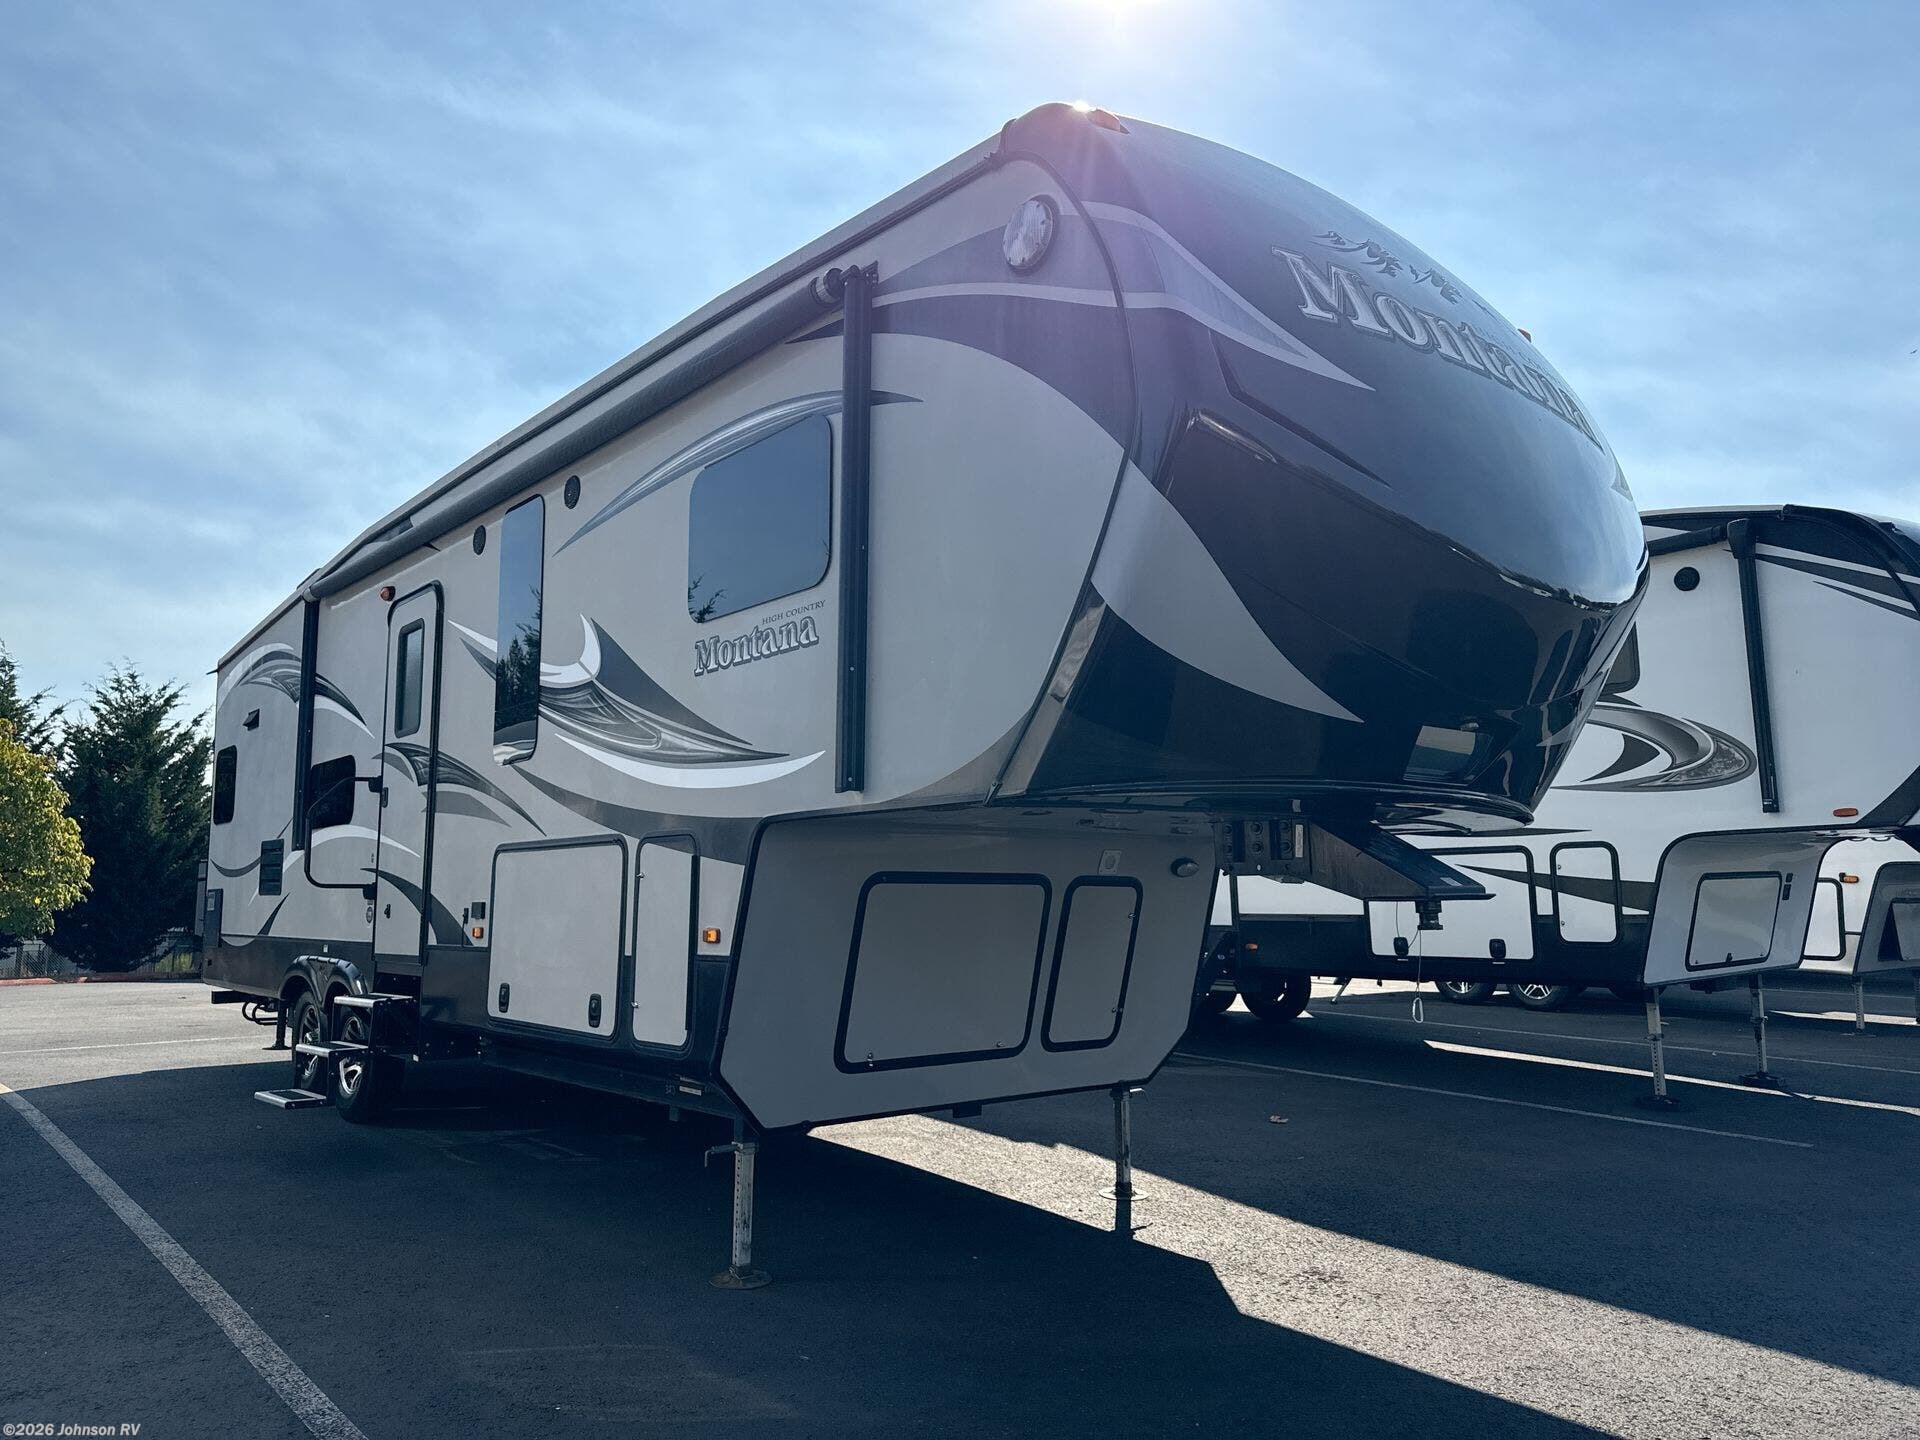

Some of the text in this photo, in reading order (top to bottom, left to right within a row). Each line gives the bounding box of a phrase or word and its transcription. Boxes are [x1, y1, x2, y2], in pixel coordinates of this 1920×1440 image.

[1271, 246, 1605, 454] Montana
[762, 599, 826, 626] HIGH COUNTRY
[694, 615, 819, 677] Montana
